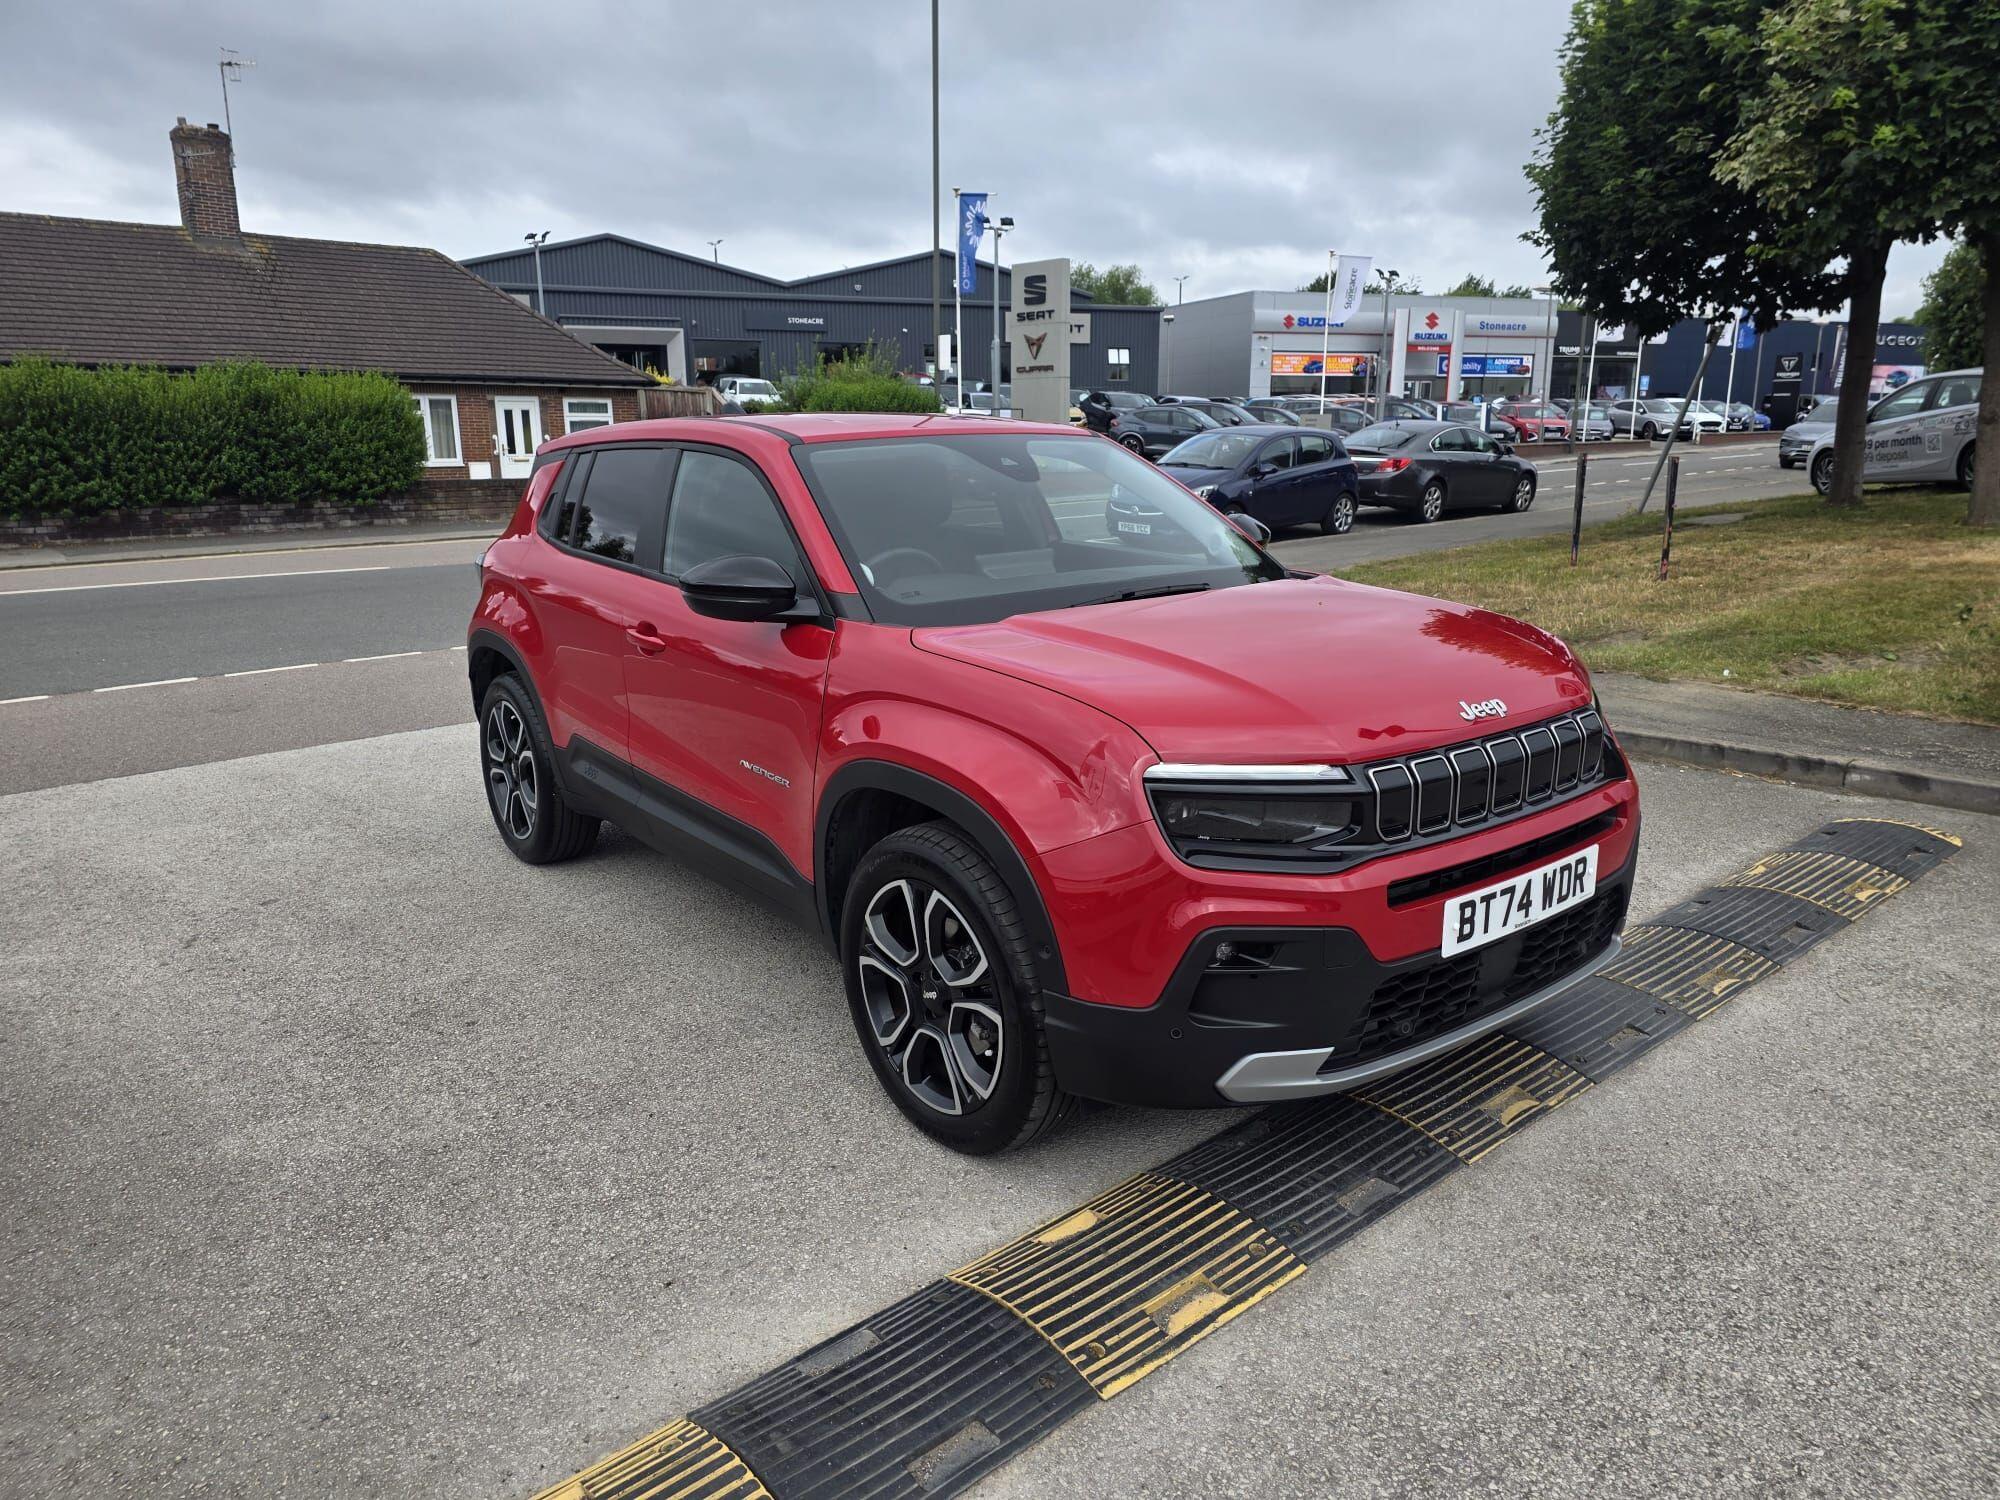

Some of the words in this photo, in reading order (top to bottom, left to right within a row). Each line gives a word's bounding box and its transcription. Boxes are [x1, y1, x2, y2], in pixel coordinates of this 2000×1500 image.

[1344, 267, 1358, 309] Stoneacre
[787, 317, 824, 325] STONEACRE
[1016, 309, 1055, 322] SEAT
[1479, 321, 1527, 331] Stoneacre
[1414, 332, 1448, 340] SUZUKI
[1462, 362, 1482, 372] obility
[1875, 439, 1889, 452] per
[1891, 434, 1923, 447] month
[1459, 698, 1508, 721] Jeep
[739, 759, 791, 788] AVENGER
[1456, 879, 1533, 944] BT74
[1541, 856, 1588, 911] WDR
